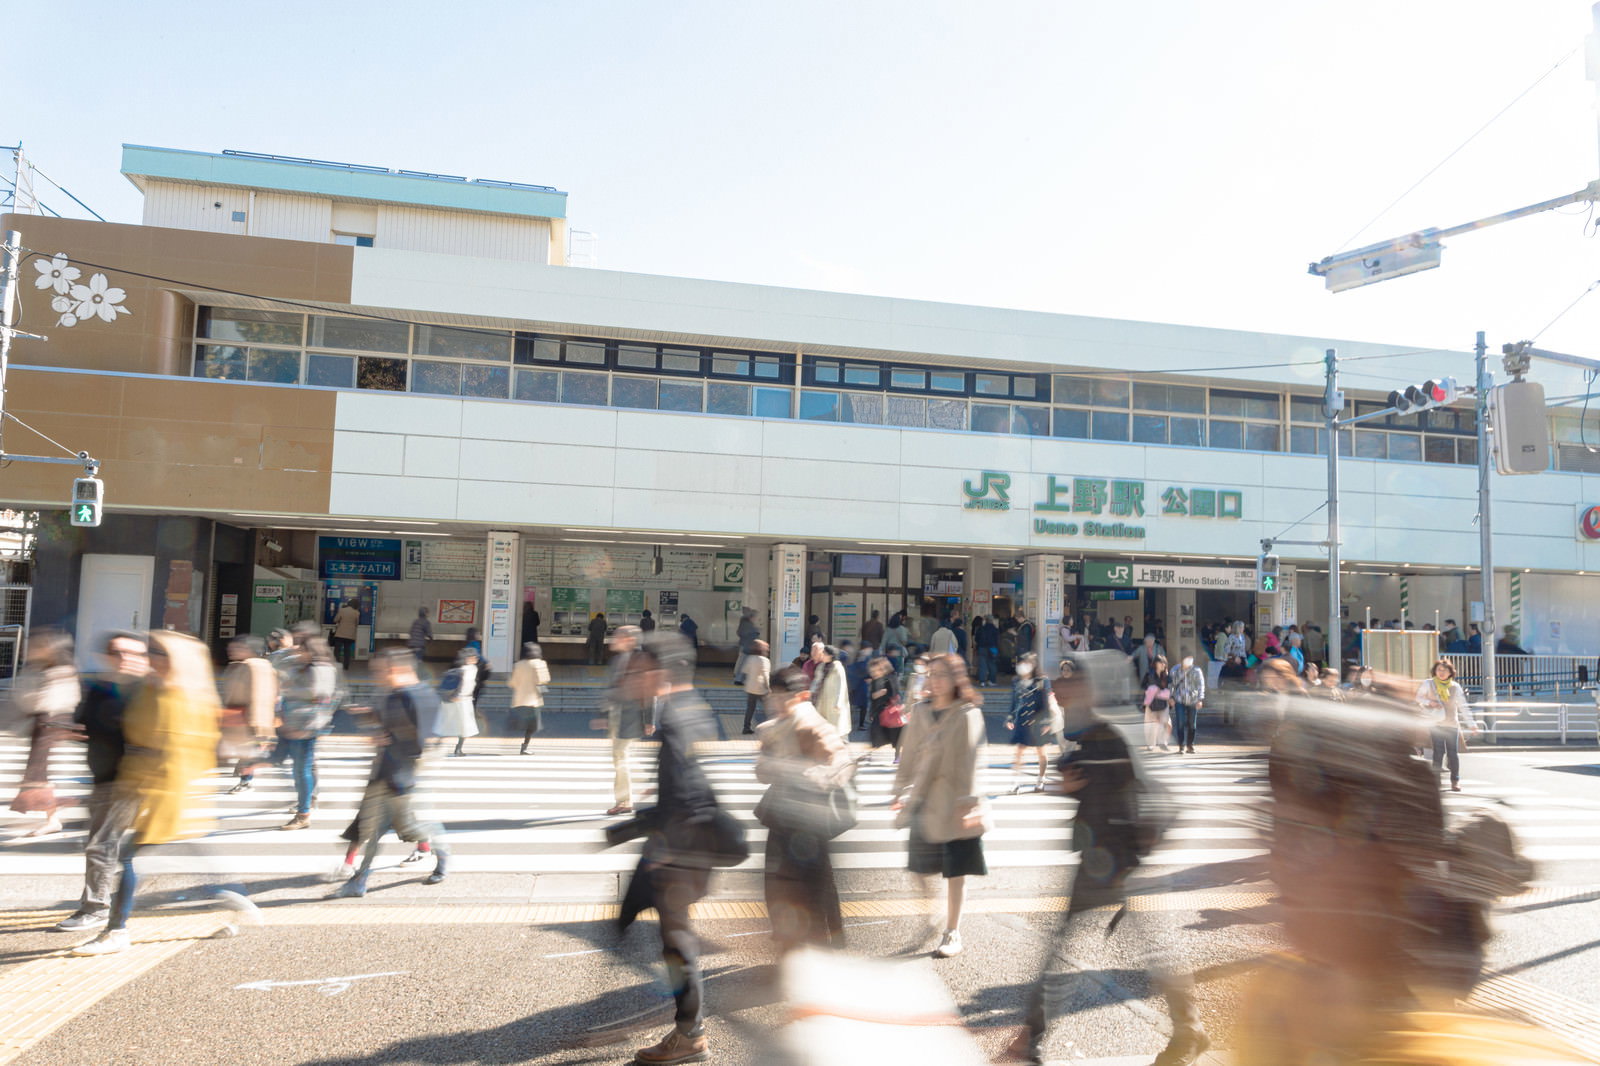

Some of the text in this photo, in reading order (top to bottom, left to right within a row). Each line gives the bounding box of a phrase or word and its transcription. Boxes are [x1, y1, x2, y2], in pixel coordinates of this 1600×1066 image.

[964, 471, 1011, 499] JR
[1034, 475, 1242, 518] 上野駅 公園口
[1034, 519, 1145, 539] Ueno Station
[330, 563, 391, 573] エキナカATM
[1107, 566, 1129, 580] JR
[1137, 568, 1175, 584] 上野駅
[1178, 576, 1199, 585] Ueno
[1201, 576, 1230, 586] Station
